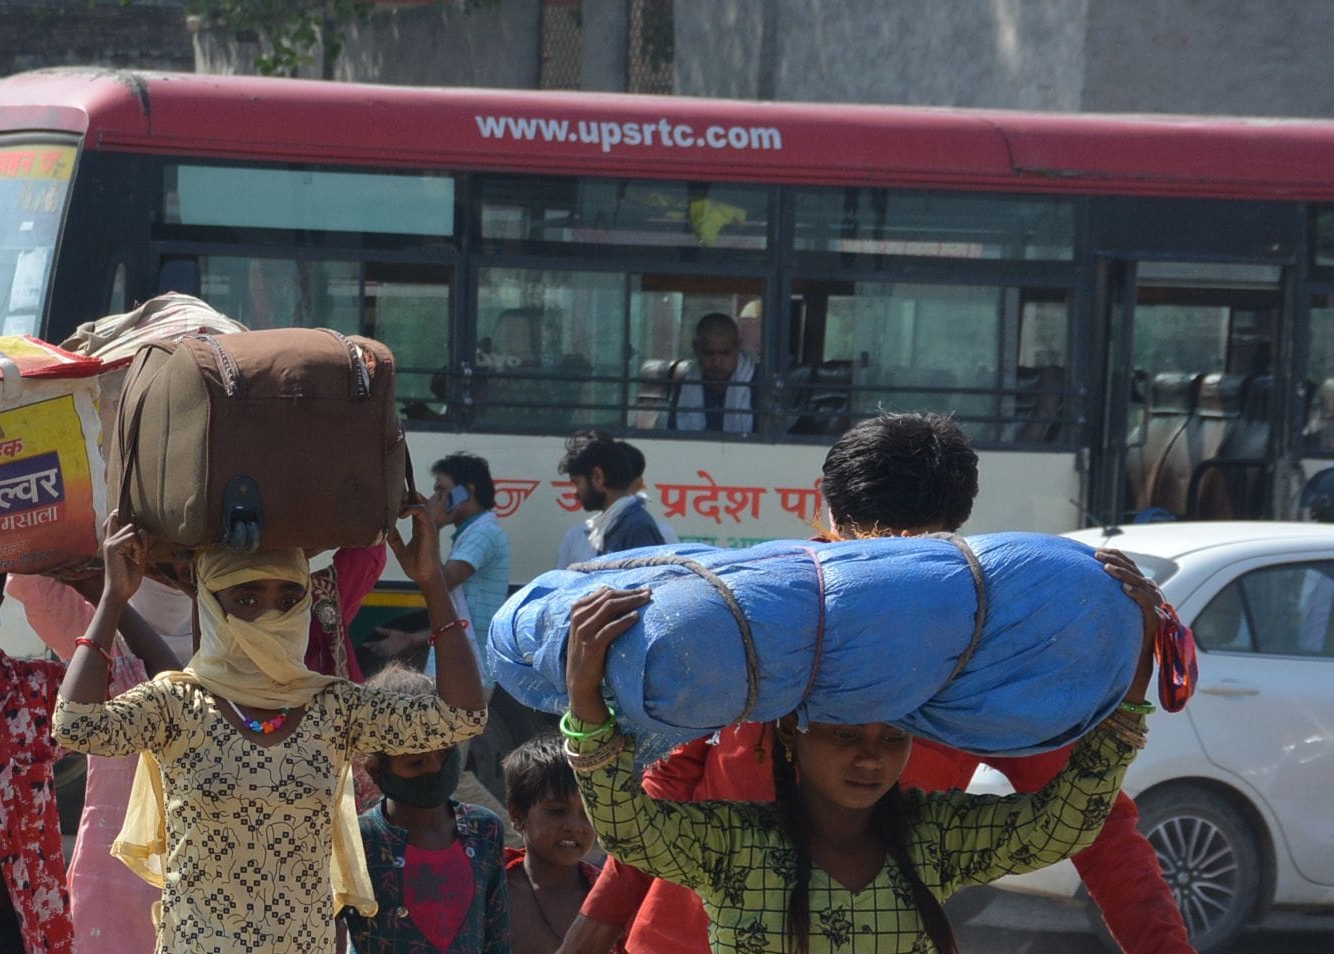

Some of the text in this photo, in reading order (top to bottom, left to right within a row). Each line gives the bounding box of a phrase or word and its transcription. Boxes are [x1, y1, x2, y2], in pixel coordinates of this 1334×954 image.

[474, 115, 783, 152] www.upsrtc.com
[654, 470, 768, 524] प्रदेश
[0, 505, 58, 531] मसाला
